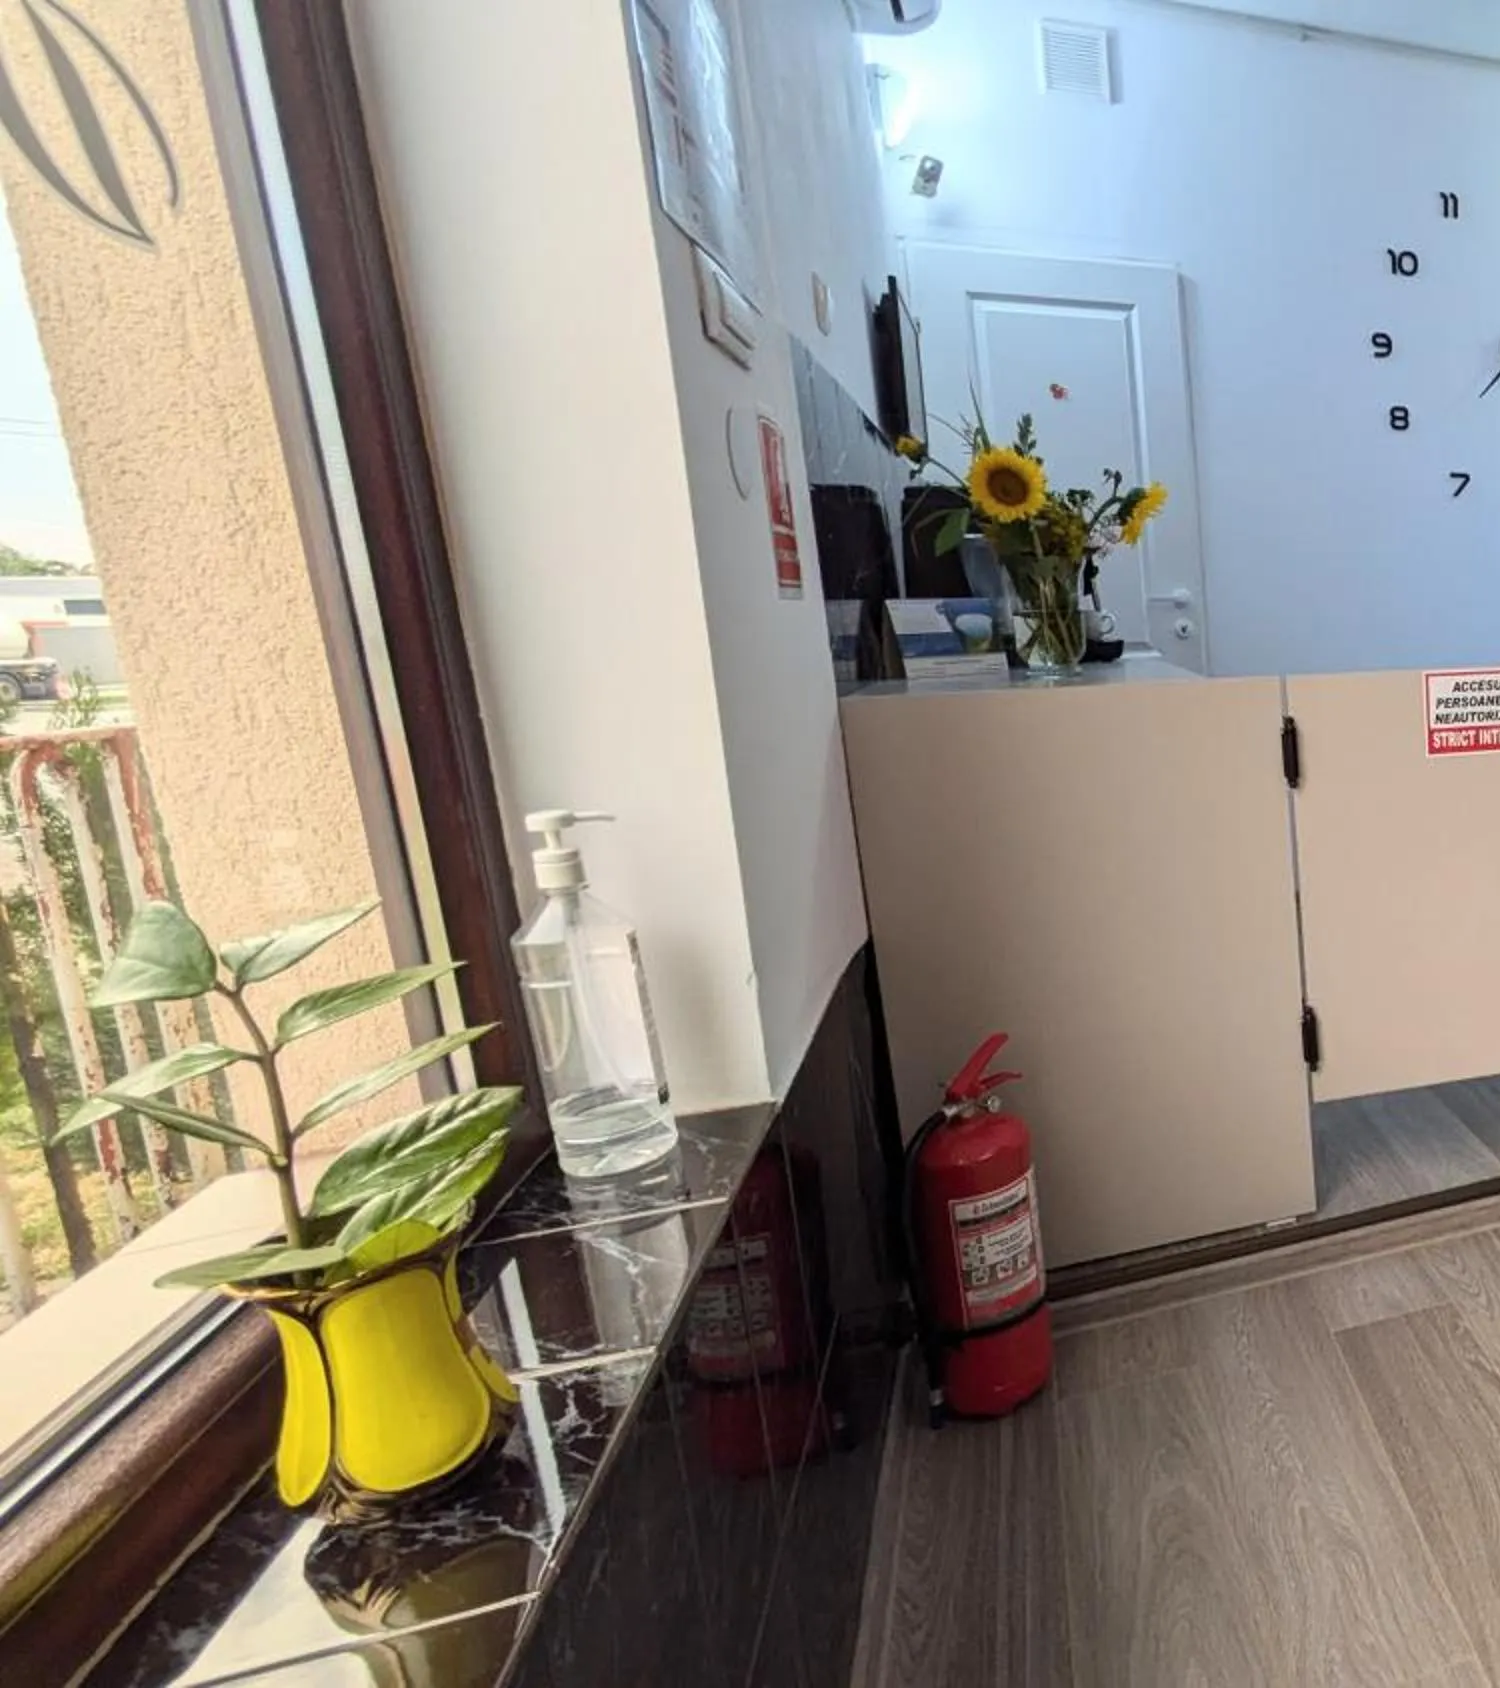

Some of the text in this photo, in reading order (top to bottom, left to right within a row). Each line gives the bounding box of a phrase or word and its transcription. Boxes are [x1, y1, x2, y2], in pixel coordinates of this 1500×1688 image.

[1439, 191, 1459, 219] 11
[1387, 248, 1419, 277] 10
[1371, 332, 1393, 359] 9
[1389, 405, 1410, 432] 8
[1449, 471, 1471, 498] 7
[1432, 729, 1477, 749] STRICT
